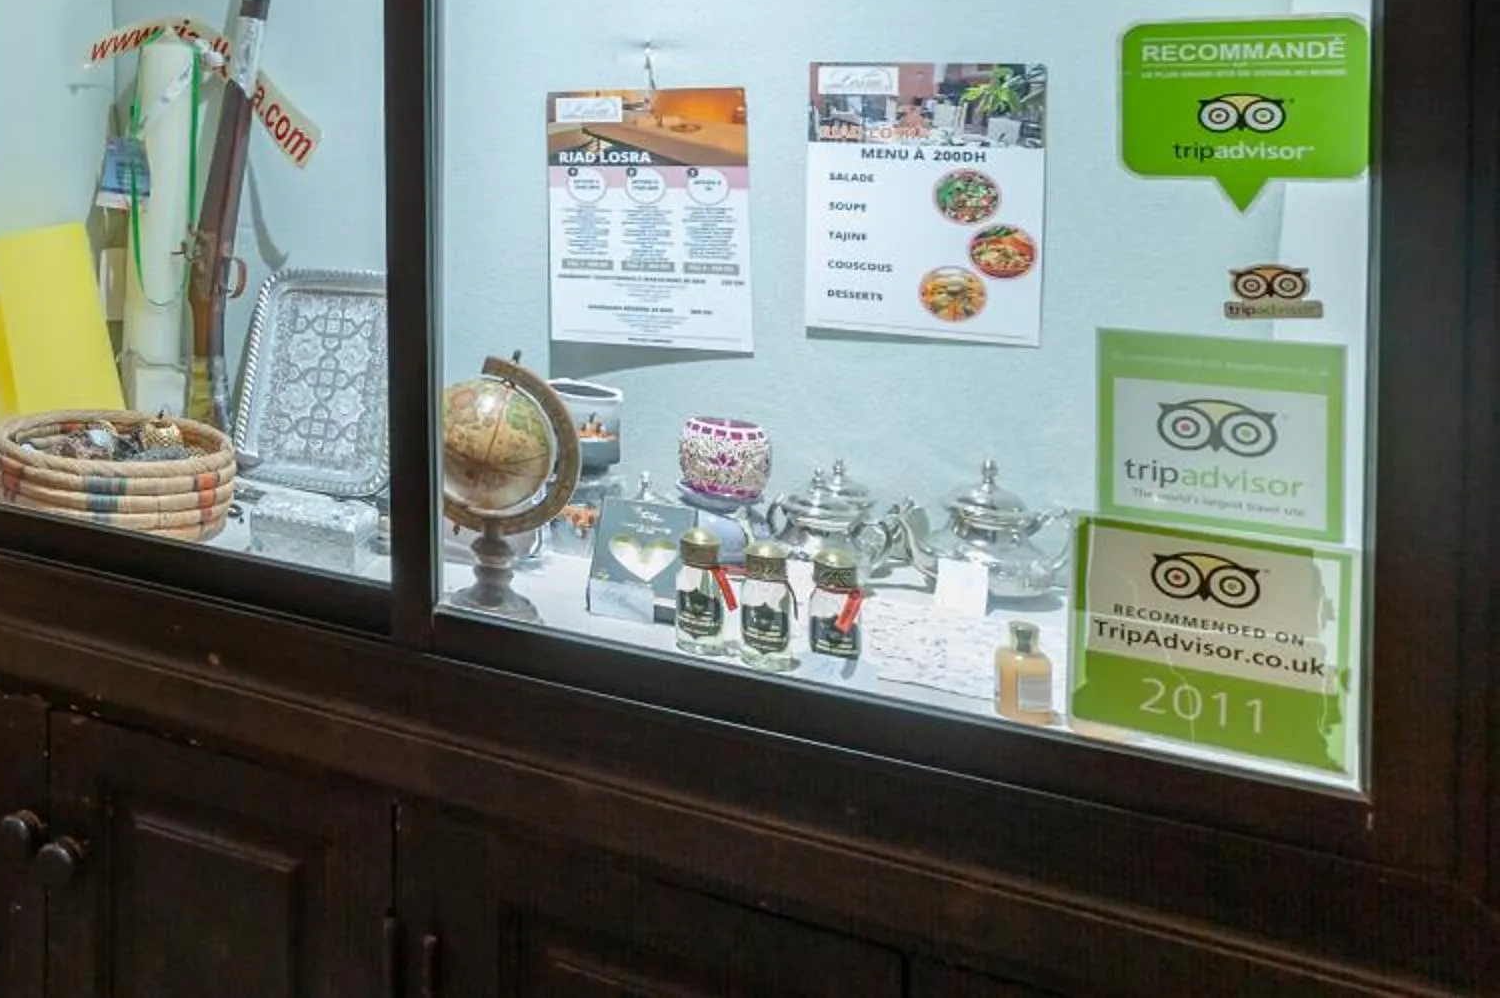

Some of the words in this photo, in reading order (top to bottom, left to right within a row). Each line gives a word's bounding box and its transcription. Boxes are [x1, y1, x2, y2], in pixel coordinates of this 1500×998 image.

[1141, 37, 1346, 62] RECOMMANDÉ
[558, 151, 596, 164] RIAD
[600, 151, 652, 164] LOSRA
[861, 148, 909, 160] MENU
[933, 150, 987, 163] 200DH
[1172, 141, 1306, 162] tripadvisor
[829, 171, 875, 183] SALADE
[828, 201, 867, 212] SOUPE
[828, 231, 867, 242] TAJINE
[827, 259, 893, 273] COUSCOUS
[827, 288, 883, 302] DESSERTS
[1124, 458, 1304, 498] tripadvisor
[1113, 603, 1266, 639] RECOMMENDED
[1275, 631, 1305, 647] ON
[1094, 619, 1324, 677] TripAdvisor.co.uk
[1139, 677, 1263, 734] 2011
